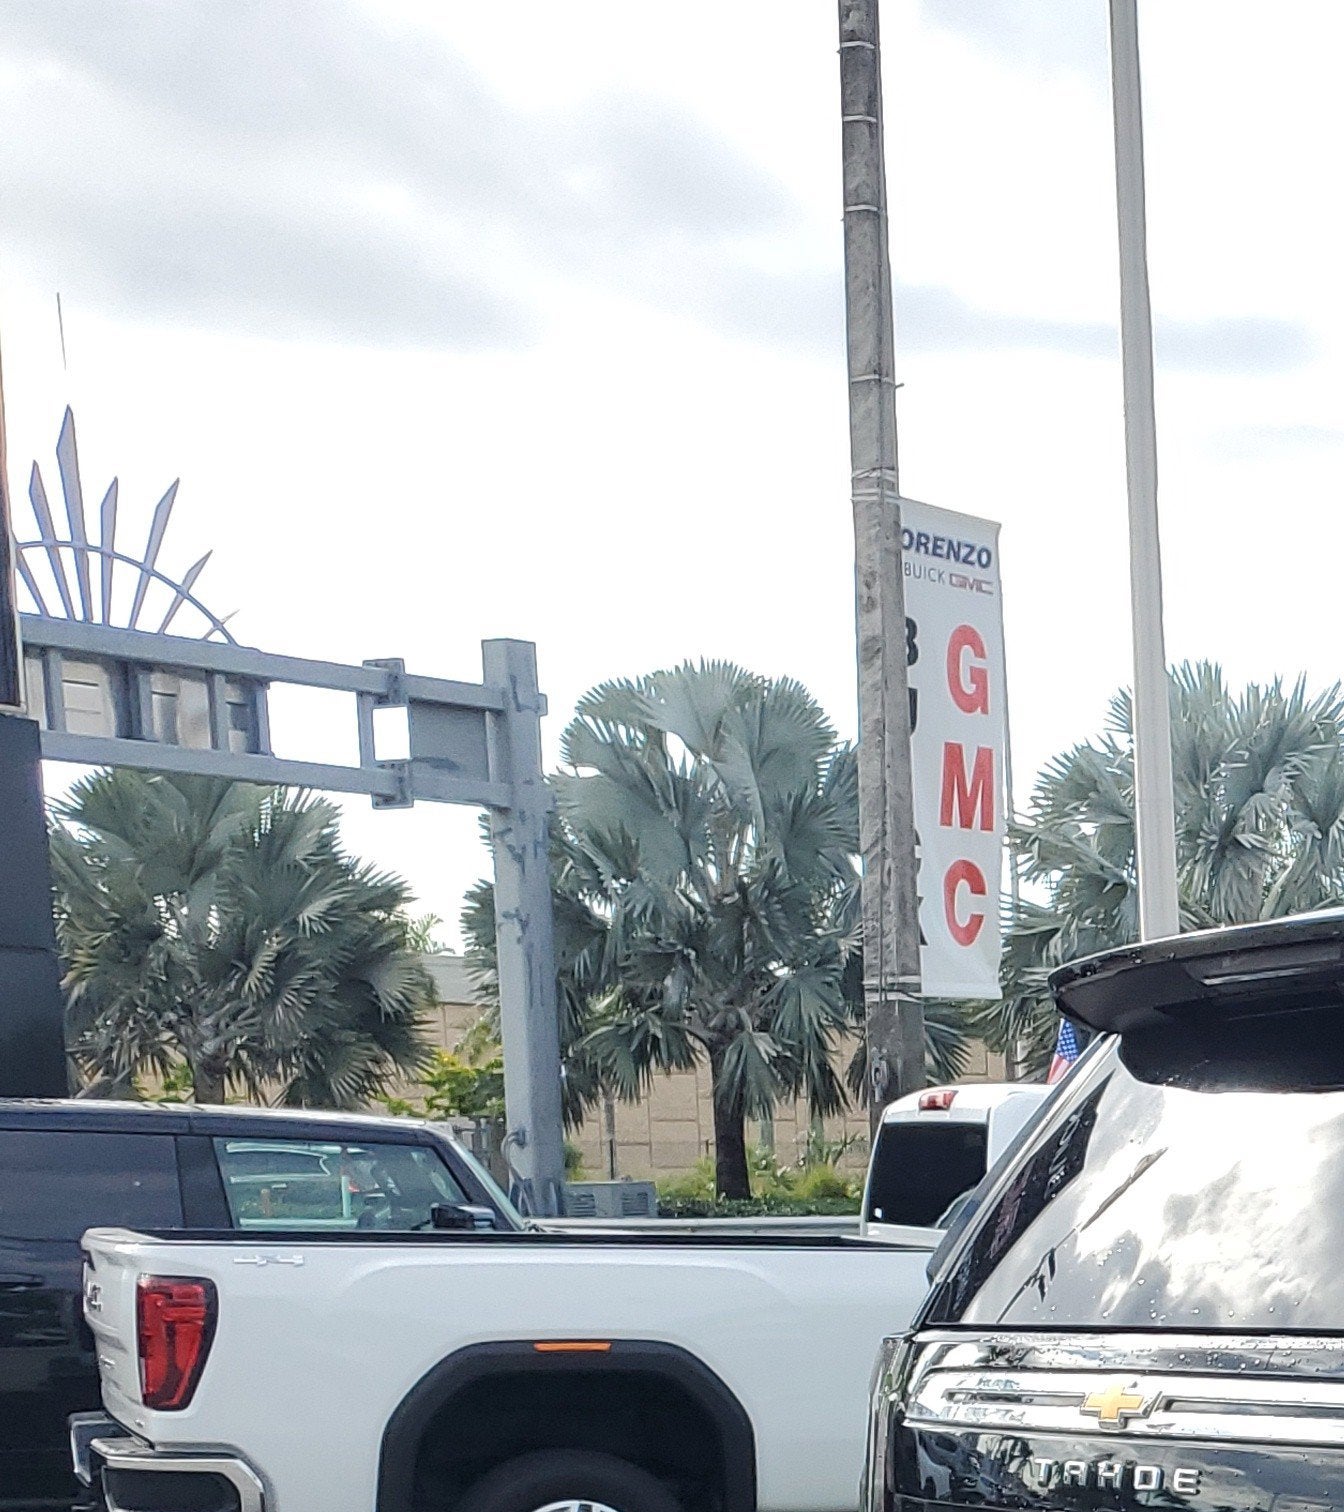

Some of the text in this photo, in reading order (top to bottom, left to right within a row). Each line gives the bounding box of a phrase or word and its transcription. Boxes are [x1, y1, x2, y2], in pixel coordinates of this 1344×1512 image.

[901, 528, 992, 569] ORENZO
[904, 562, 994, 595] BUICK GMC
[1034, 1457, 1203, 1496] TAHOE
